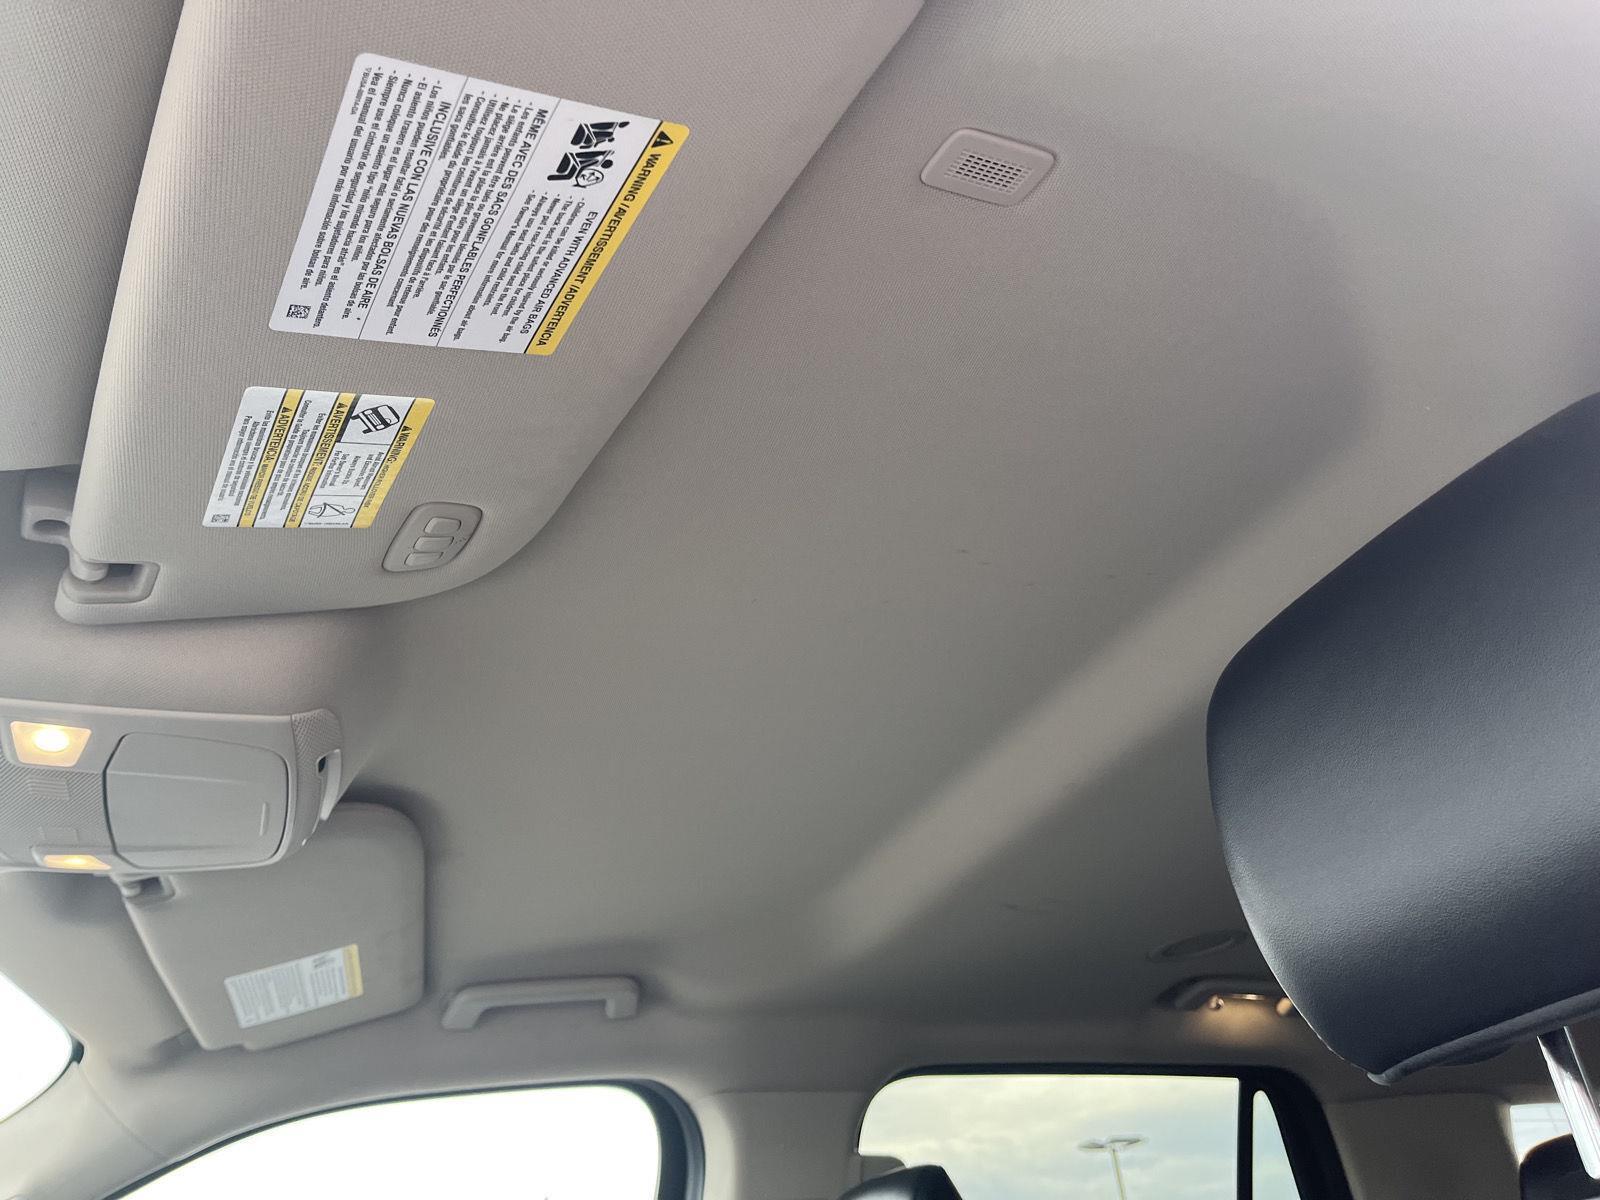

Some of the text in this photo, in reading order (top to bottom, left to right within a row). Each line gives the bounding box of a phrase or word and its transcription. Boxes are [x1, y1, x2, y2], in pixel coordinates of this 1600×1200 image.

[511, 140, 531, 168] AVEC
[622, 153, 661, 202] WARNING
[487, 190, 508, 216] SACS
[500, 169, 519, 189] DES
[357, 100, 451, 309] INCLUSIVE CON LAS NUEVAS BOLSAS DE AIRE
[458, 216, 494, 273] GONFLABLES
[519, 210, 598, 334] EVEN WITH ADVANCED AIR BAGS
[427, 273, 466, 337] PERFECTIONNÉS
[262, 413, 290, 462] ADVERTENCIA:
[311, 409, 345, 466] AVERTISSEMENT:
[385, 432, 410, 463] WARNING:
